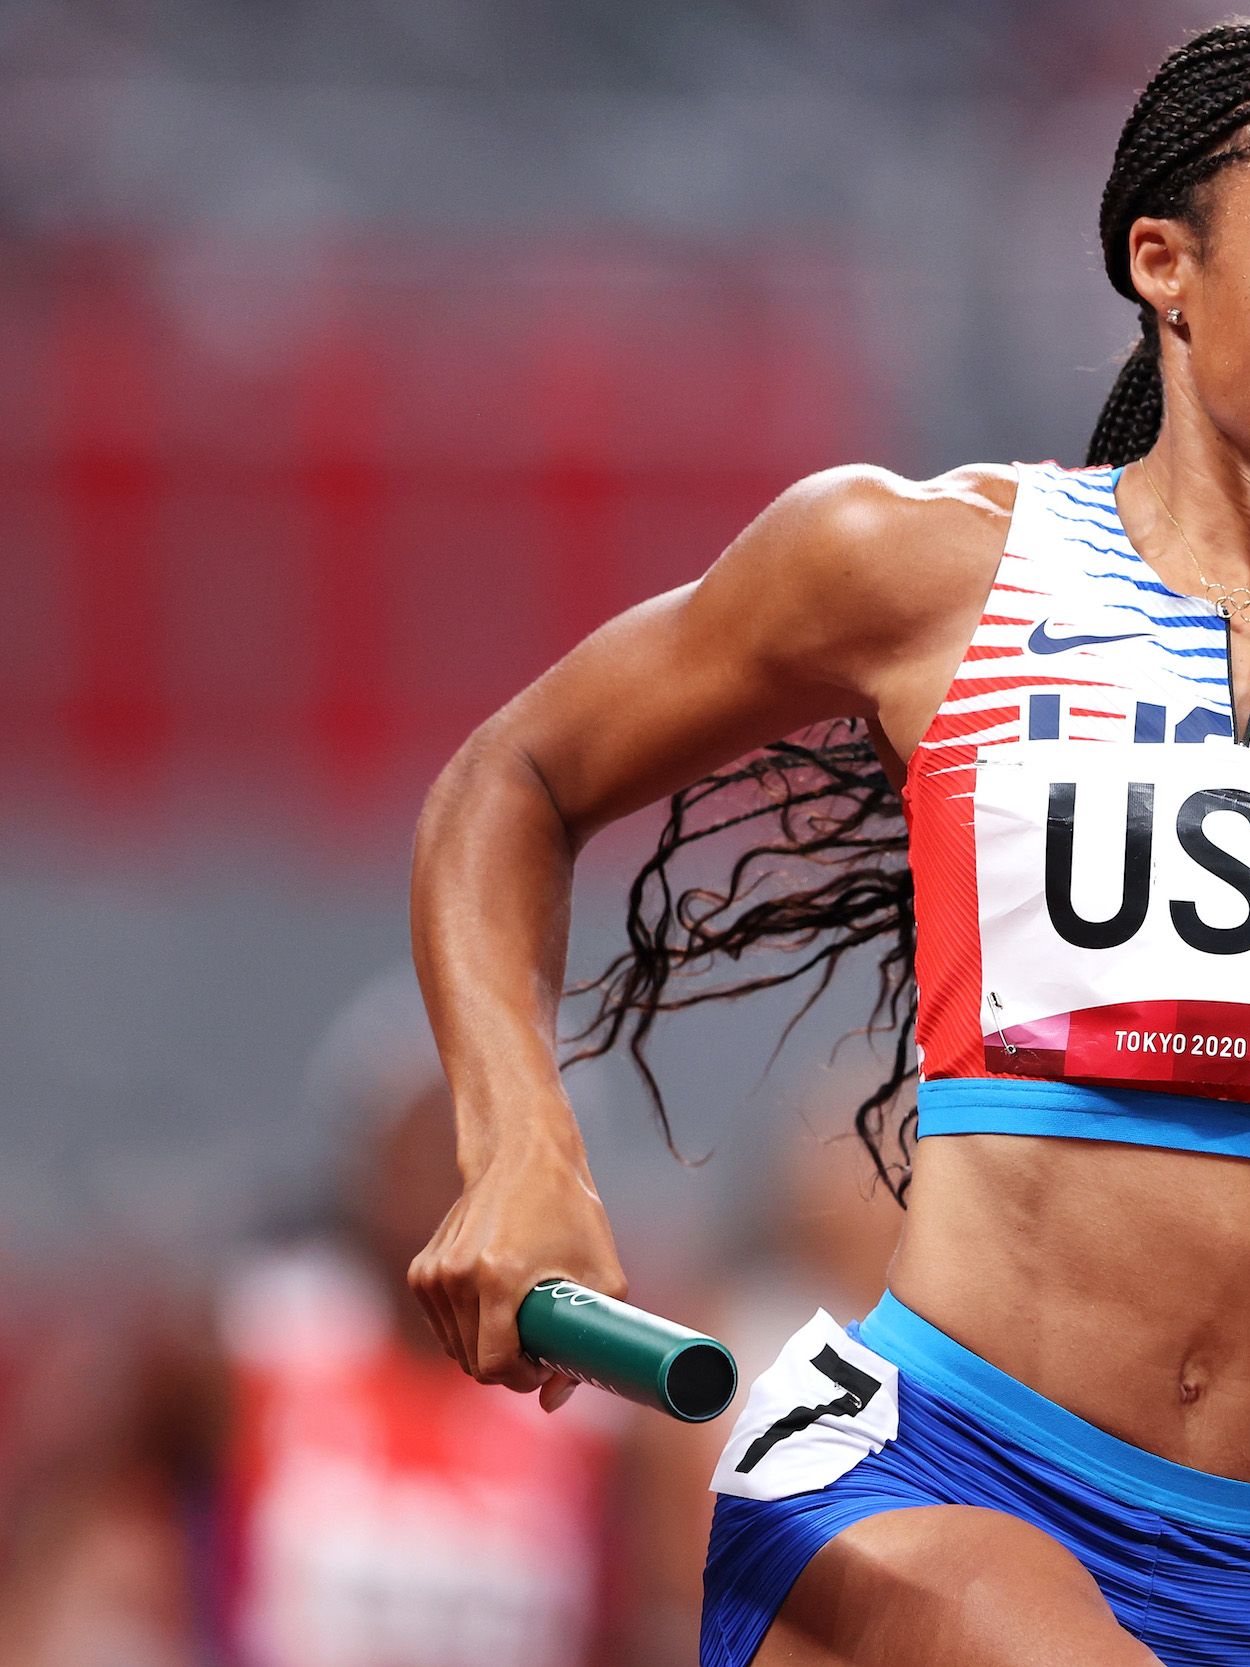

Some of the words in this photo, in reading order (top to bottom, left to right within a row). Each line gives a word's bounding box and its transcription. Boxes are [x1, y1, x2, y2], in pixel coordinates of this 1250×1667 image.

[1115, 1030, 1187, 1054] TOKYO
[1191, 1034, 1247, 1058] 2020
[735, 1343, 881, 1474] 7
